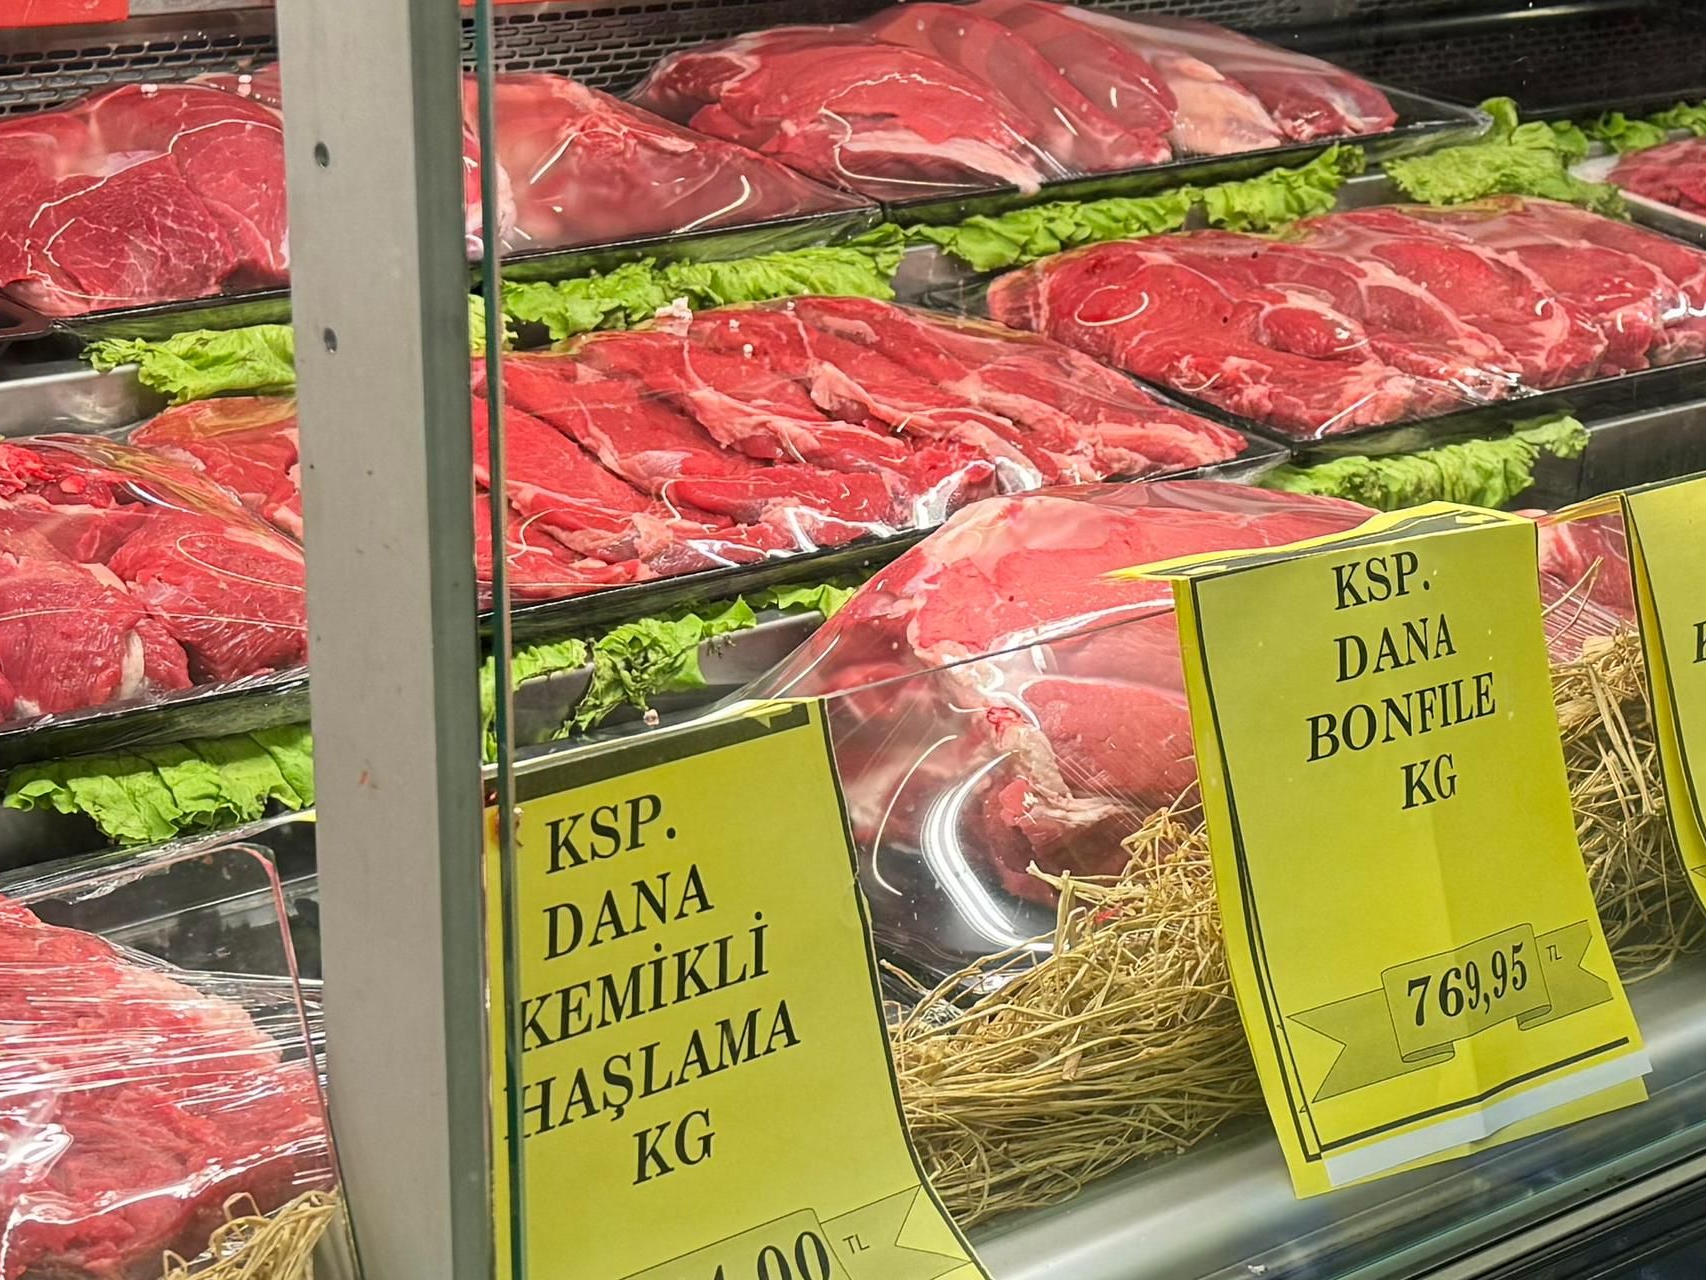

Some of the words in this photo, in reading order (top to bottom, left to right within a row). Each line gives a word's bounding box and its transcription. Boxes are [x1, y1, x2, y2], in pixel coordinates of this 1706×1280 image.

[1331, 550, 1431, 611] KSP.
[1333, 612, 1458, 683] DANA
[1305, 670, 1497, 765] BONFILE
[1399, 753, 1459, 811] KG
[543, 793, 678, 876] KSP.
[542, 863, 715, 963] DANA
[1545, 944, 1564, 962] TL
[514, 910, 773, 1054] KEMİKLİ
[1405, 940, 1530, 1028] 769,95
[503, 999, 802, 1142] HAŞLAMA
[630, 1107, 717, 1186] KG
[843, 1233, 870, 1256] TL
